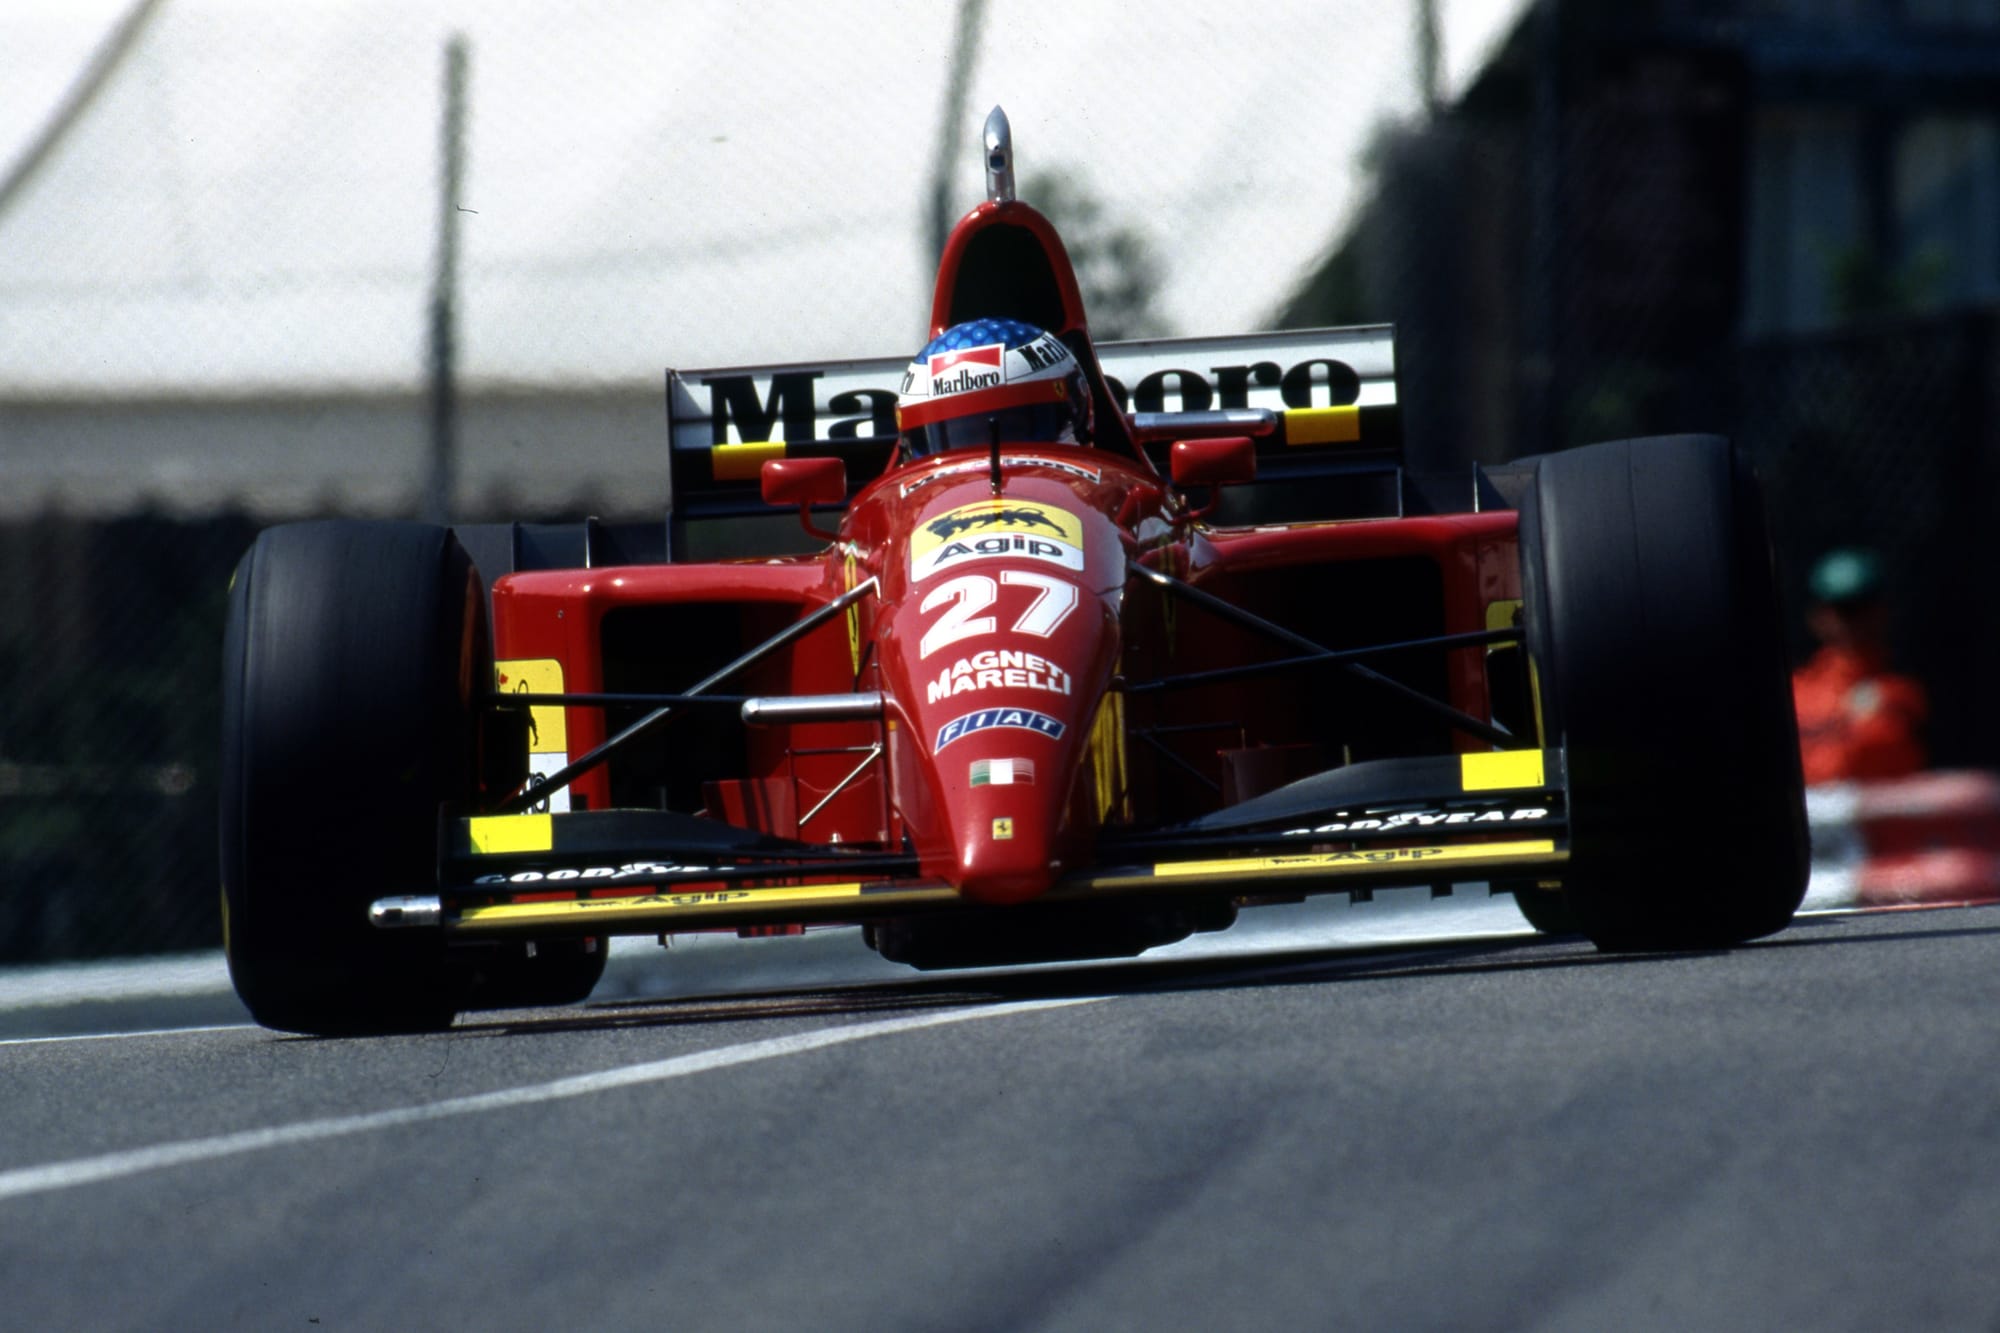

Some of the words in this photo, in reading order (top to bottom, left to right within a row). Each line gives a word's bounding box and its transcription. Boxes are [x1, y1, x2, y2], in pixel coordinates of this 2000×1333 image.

[933, 369, 1000, 396] Marlboro
[702, 359, 1361, 445] Maoro
[934, 535, 1063, 566] Agip
[920, 570, 1079, 661] 27
[928, 650, 1071, 693] MAGNETI
[928, 668, 1071, 704] MARELLI
[943, 711, 1057, 742] FIAT
